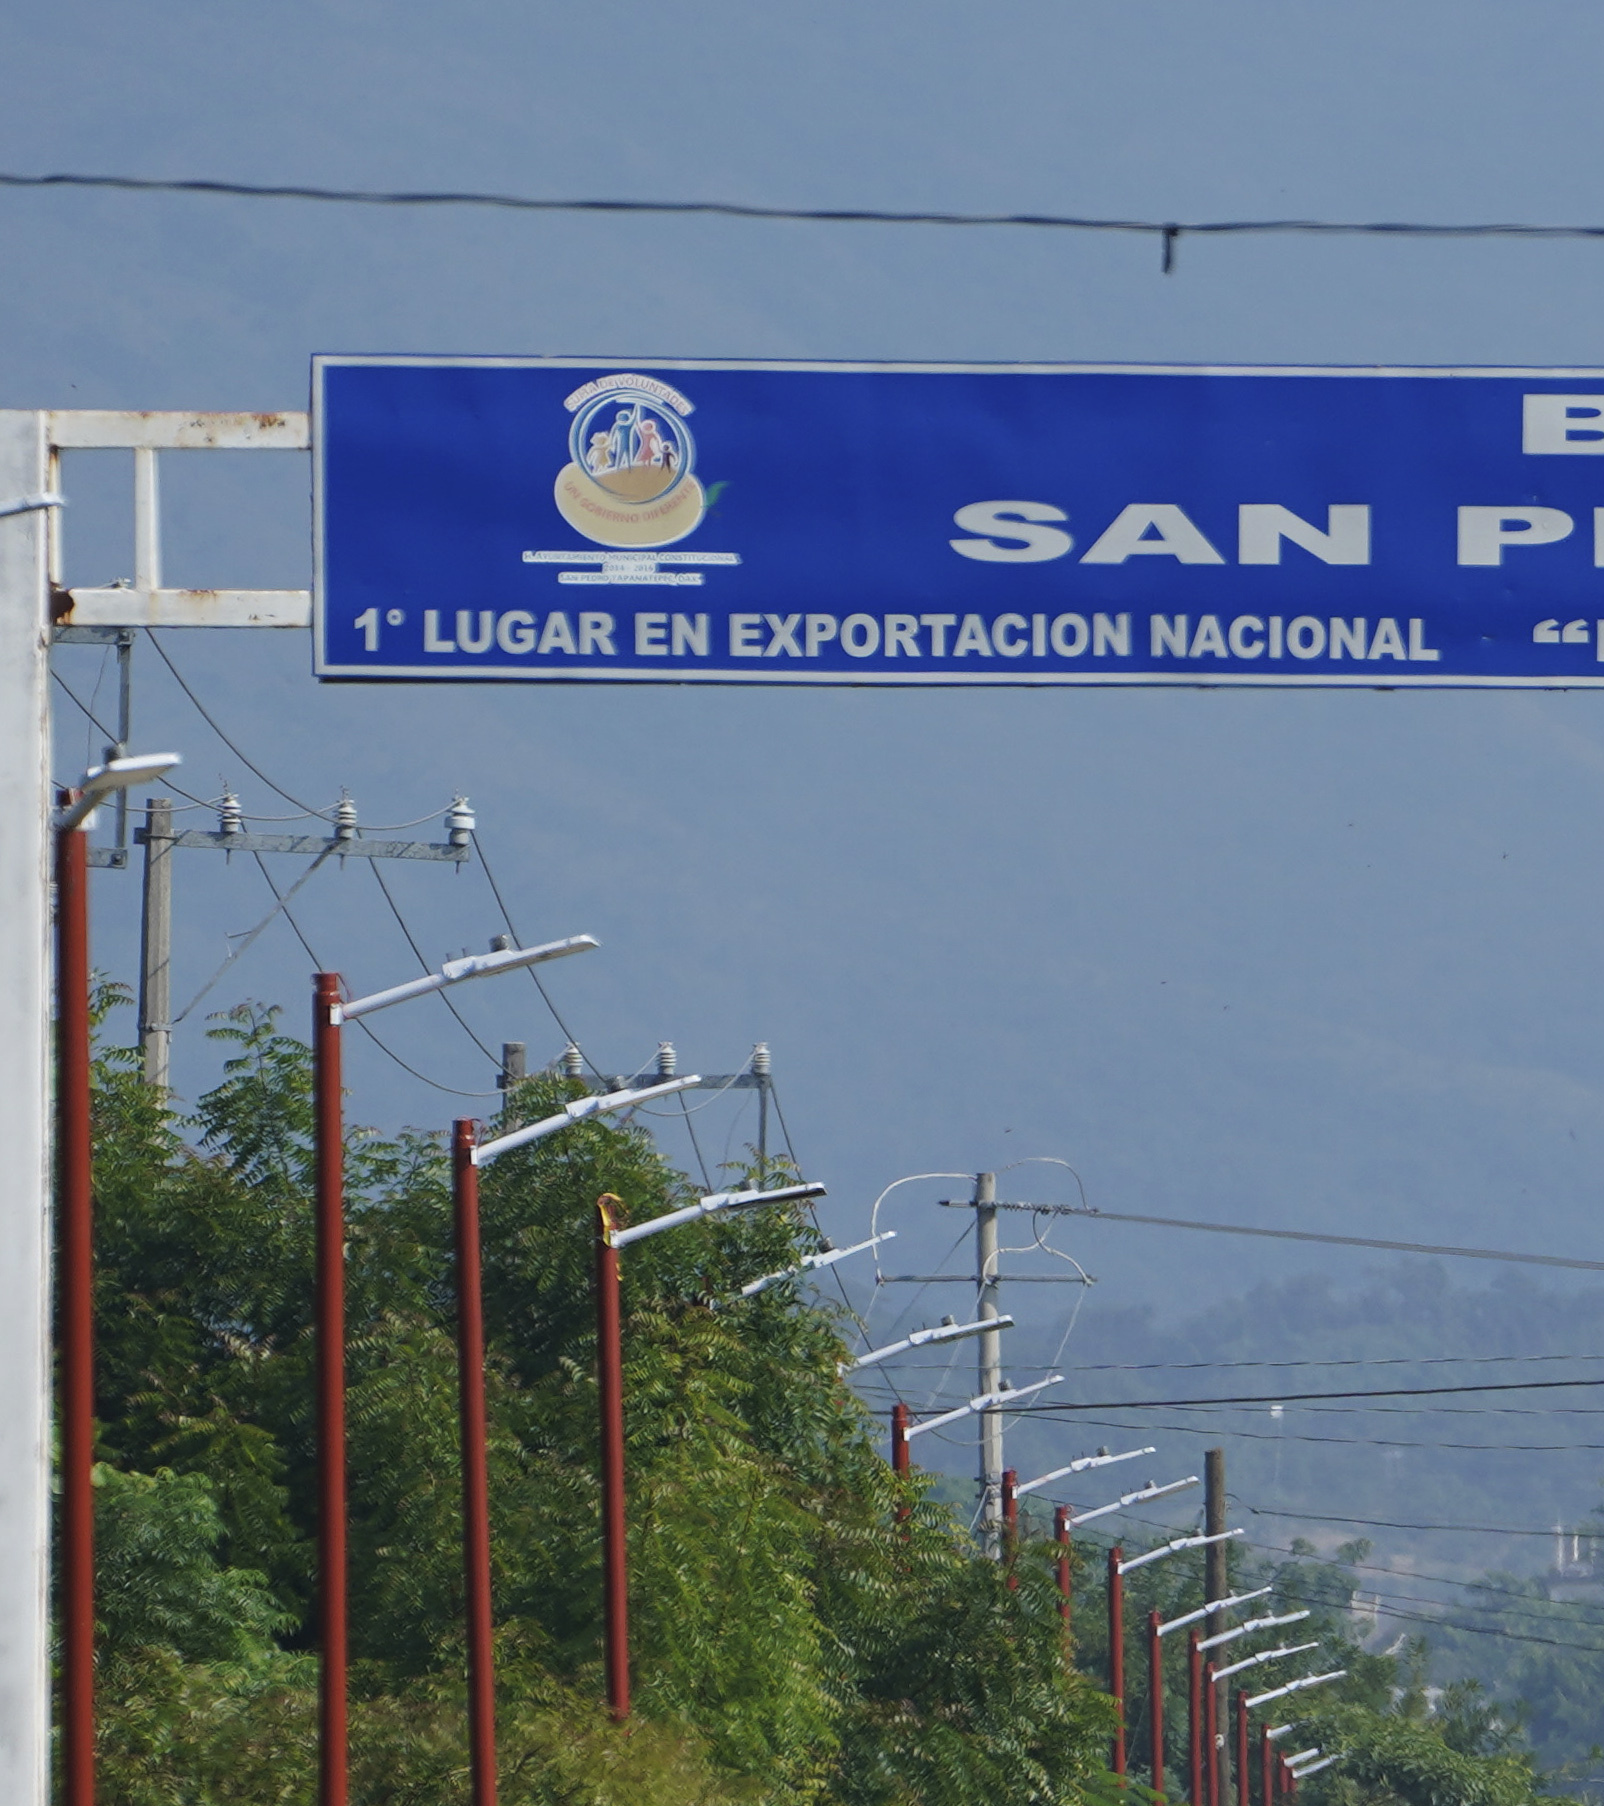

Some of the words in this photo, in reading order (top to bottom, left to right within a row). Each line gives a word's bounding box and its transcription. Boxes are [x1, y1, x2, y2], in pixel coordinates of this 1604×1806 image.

[580, 497, 640, 523] GOBIERNO
[949, 500, 1370, 565] SAN
[423, 609, 616, 655] LUGAR
[634, 612, 709, 656] EN
[729, 612, 1131, 658] EXPORTACION
[1150, 614, 1440, 661] NACIONAL
